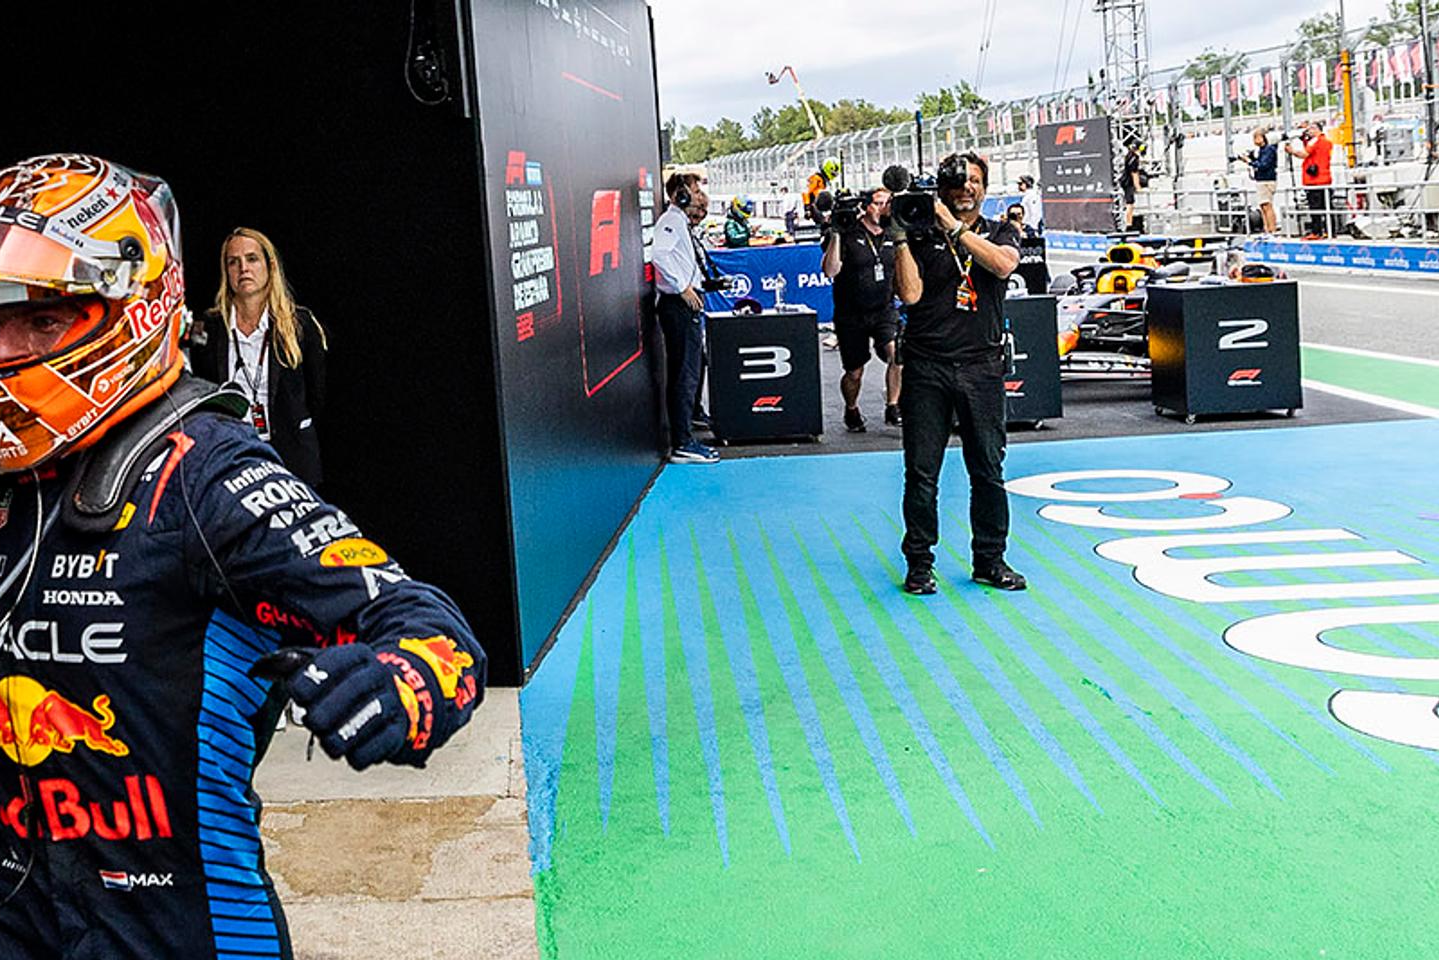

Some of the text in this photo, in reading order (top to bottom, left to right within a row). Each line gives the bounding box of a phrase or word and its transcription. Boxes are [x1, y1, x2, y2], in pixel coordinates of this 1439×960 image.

[1218, 319, 1269, 350] 2
[738, 346, 793, 381] 3
[51, 549, 120, 579] BYBIT
[42, 590, 125, 606] HONDA
[38, 774, 173, 841] Bull
[128, 872, 174, 887] MAX
